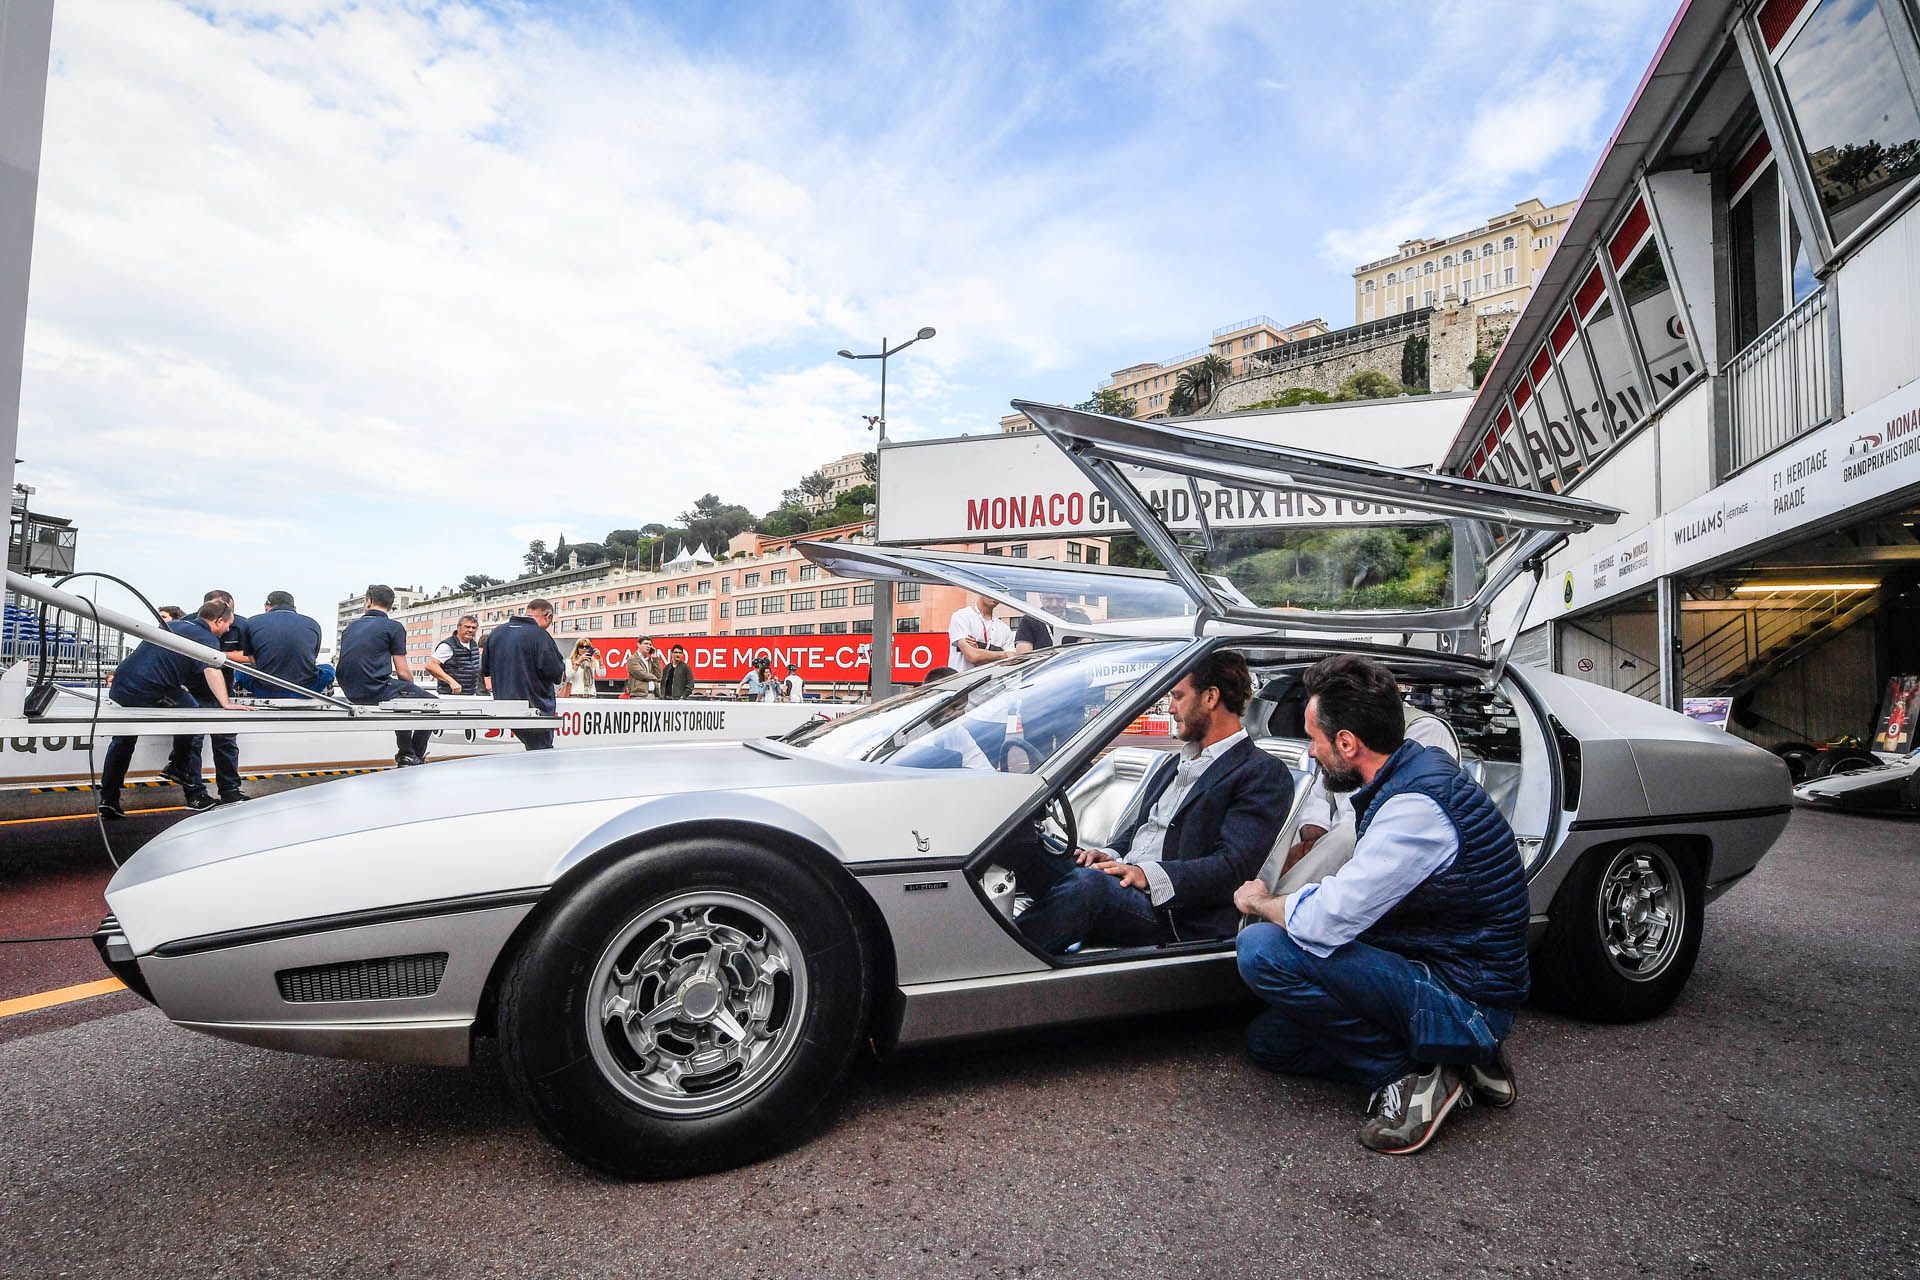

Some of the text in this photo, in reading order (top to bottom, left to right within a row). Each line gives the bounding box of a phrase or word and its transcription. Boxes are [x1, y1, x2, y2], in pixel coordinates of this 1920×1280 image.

[1887, 408, 1920, 442] MONA
[1773, 449, 1828, 491] F1 HERITAGE
[1843, 460, 1866, 483] GRAND
[1867, 451, 1885, 473] PRIX
[967, 491, 1084, 531] MONACO
[1089, 488, 1190, 524] GND
[1773, 486, 1806, 516] PARADE
[1674, 510, 1723, 546] WILLIAMS
[695, 648, 727, 668] DE
[733, 645, 933, 668] MONTE-CALO
[583, 711, 631, 735] GRAND
[632, 711, 661, 733] PRIX
[663, 710, 726, 732] HISTORIQUE
